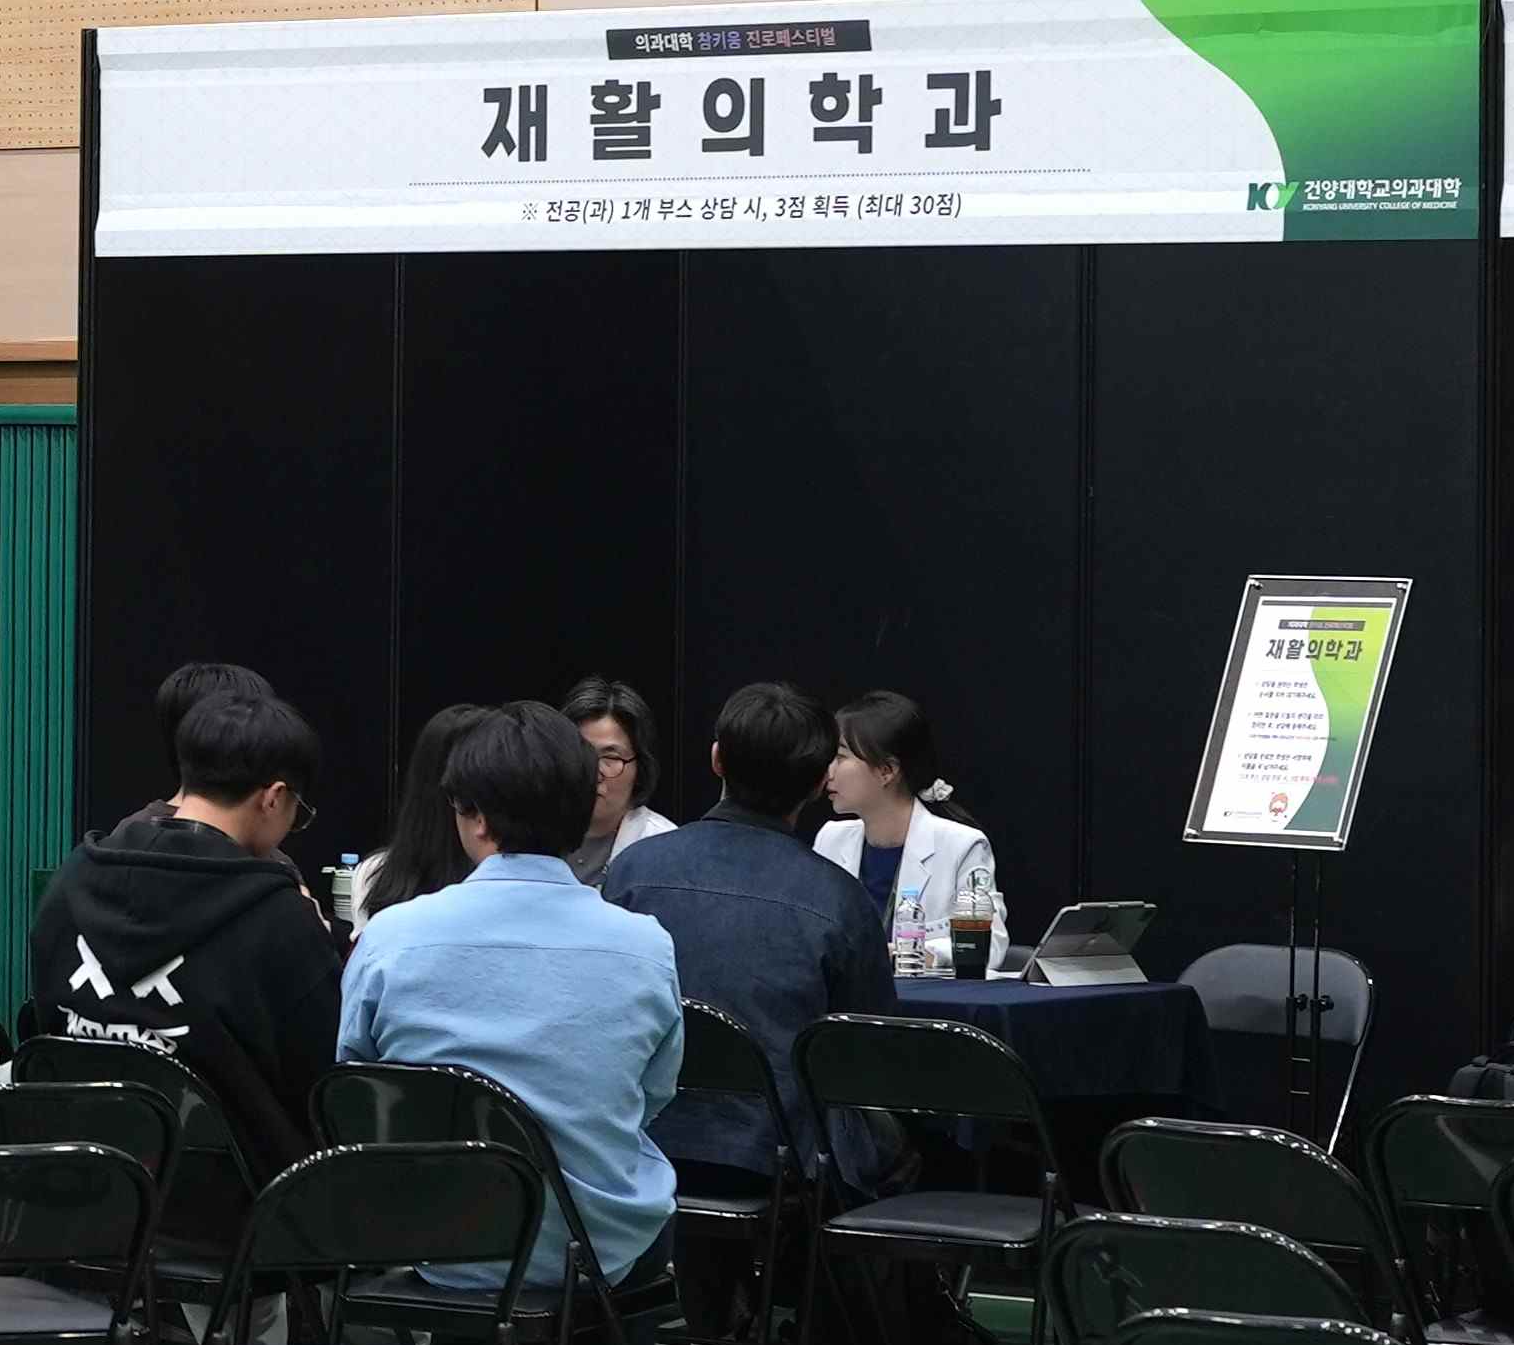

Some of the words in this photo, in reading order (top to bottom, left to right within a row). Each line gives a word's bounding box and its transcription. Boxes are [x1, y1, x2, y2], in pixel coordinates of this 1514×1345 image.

[635, 32, 693, 52] 의과대학
[481, 70, 1001, 162] 재활의학과
[1304, 178, 1462, 200] 건양대학교의과대학
[547, 200, 613, 223] 전공(과)
[622, 199, 650, 220] 1개
[658, 199, 692, 220] 부스
[701, 198, 737, 219] 상담
[744, 197, 766, 221] 시,
[775, 196, 805, 218] 3점
[814, 196, 849, 217] 획득
[858, 194, 903, 219] (최대
[910, 194, 961, 218] 30점)
[1379, 202, 1410, 210] COLLEGE
[1266, 639, 1363, 661] 재활의학과
